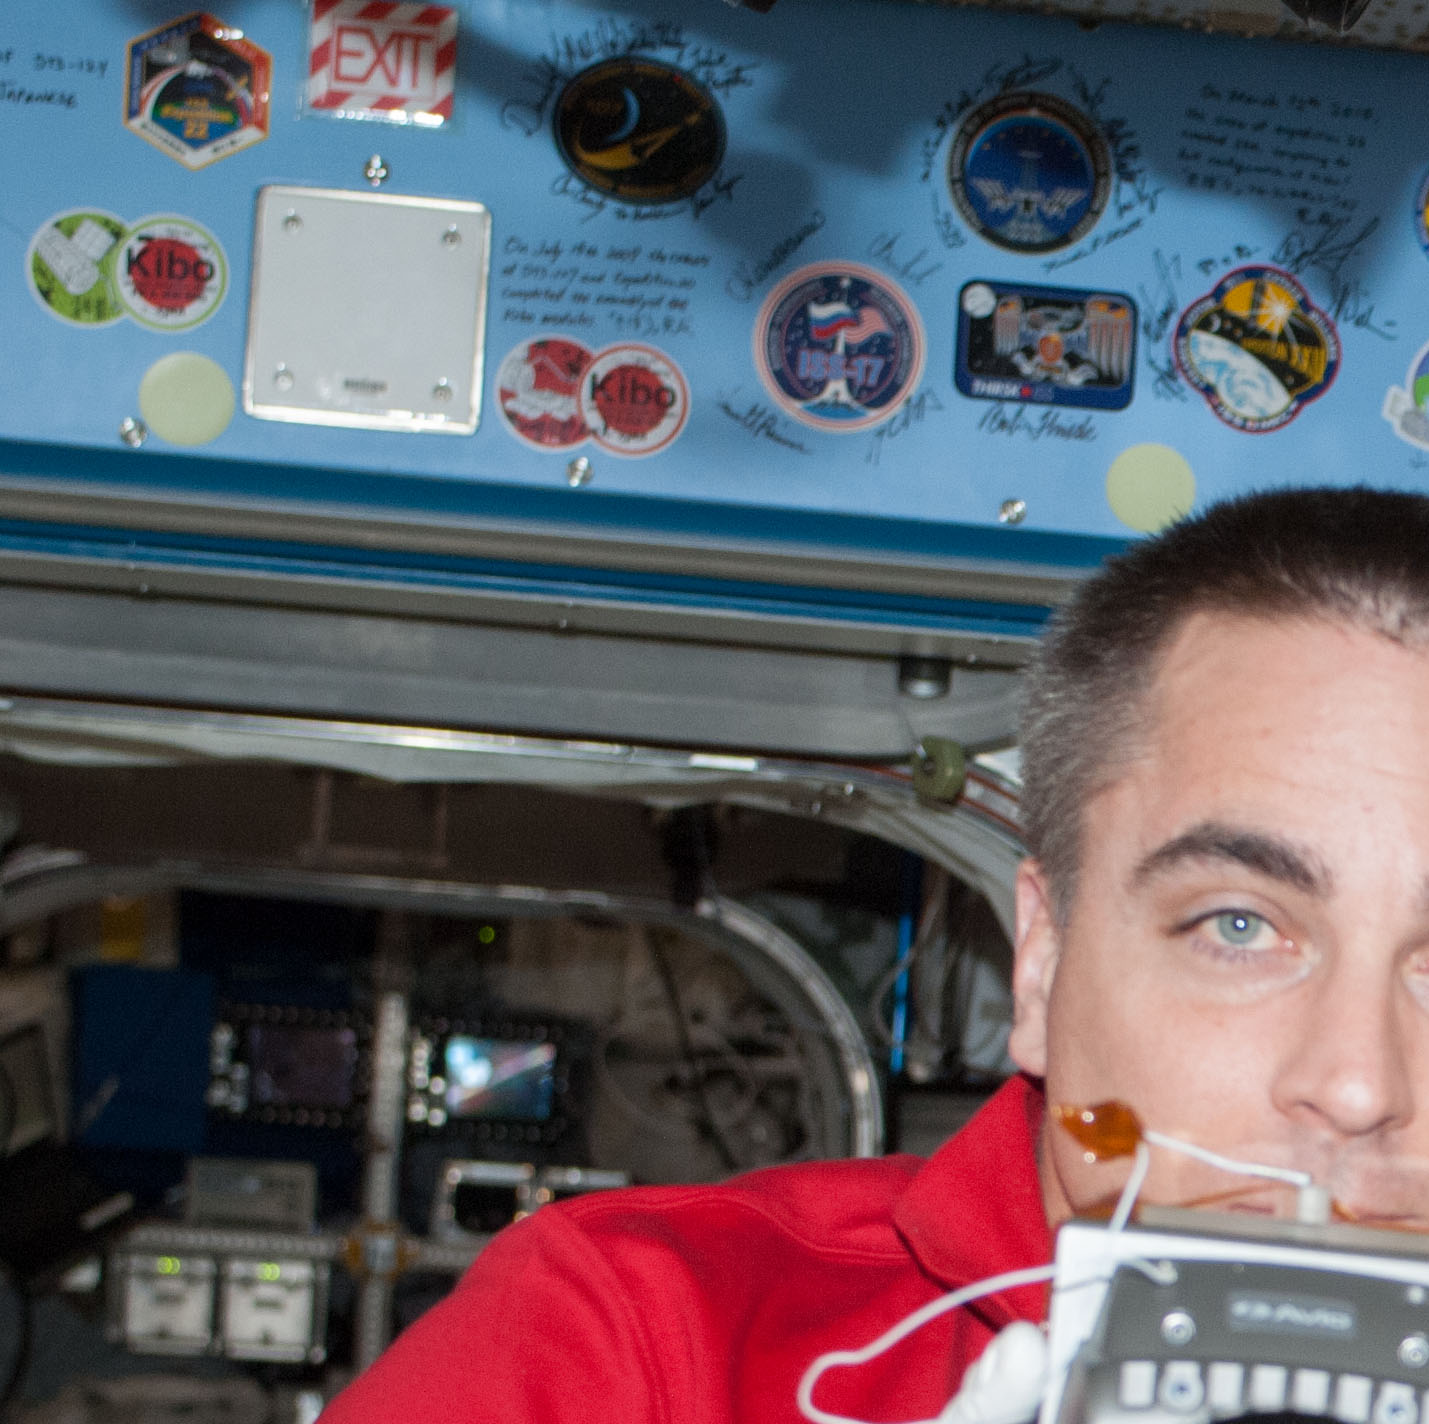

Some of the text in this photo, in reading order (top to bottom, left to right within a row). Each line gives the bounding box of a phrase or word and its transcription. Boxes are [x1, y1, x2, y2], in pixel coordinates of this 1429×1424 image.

[332, 25, 437, 90] EXIT
[127, 235, 215, 284] Kibo
[590, 371, 678, 408] Kibo
